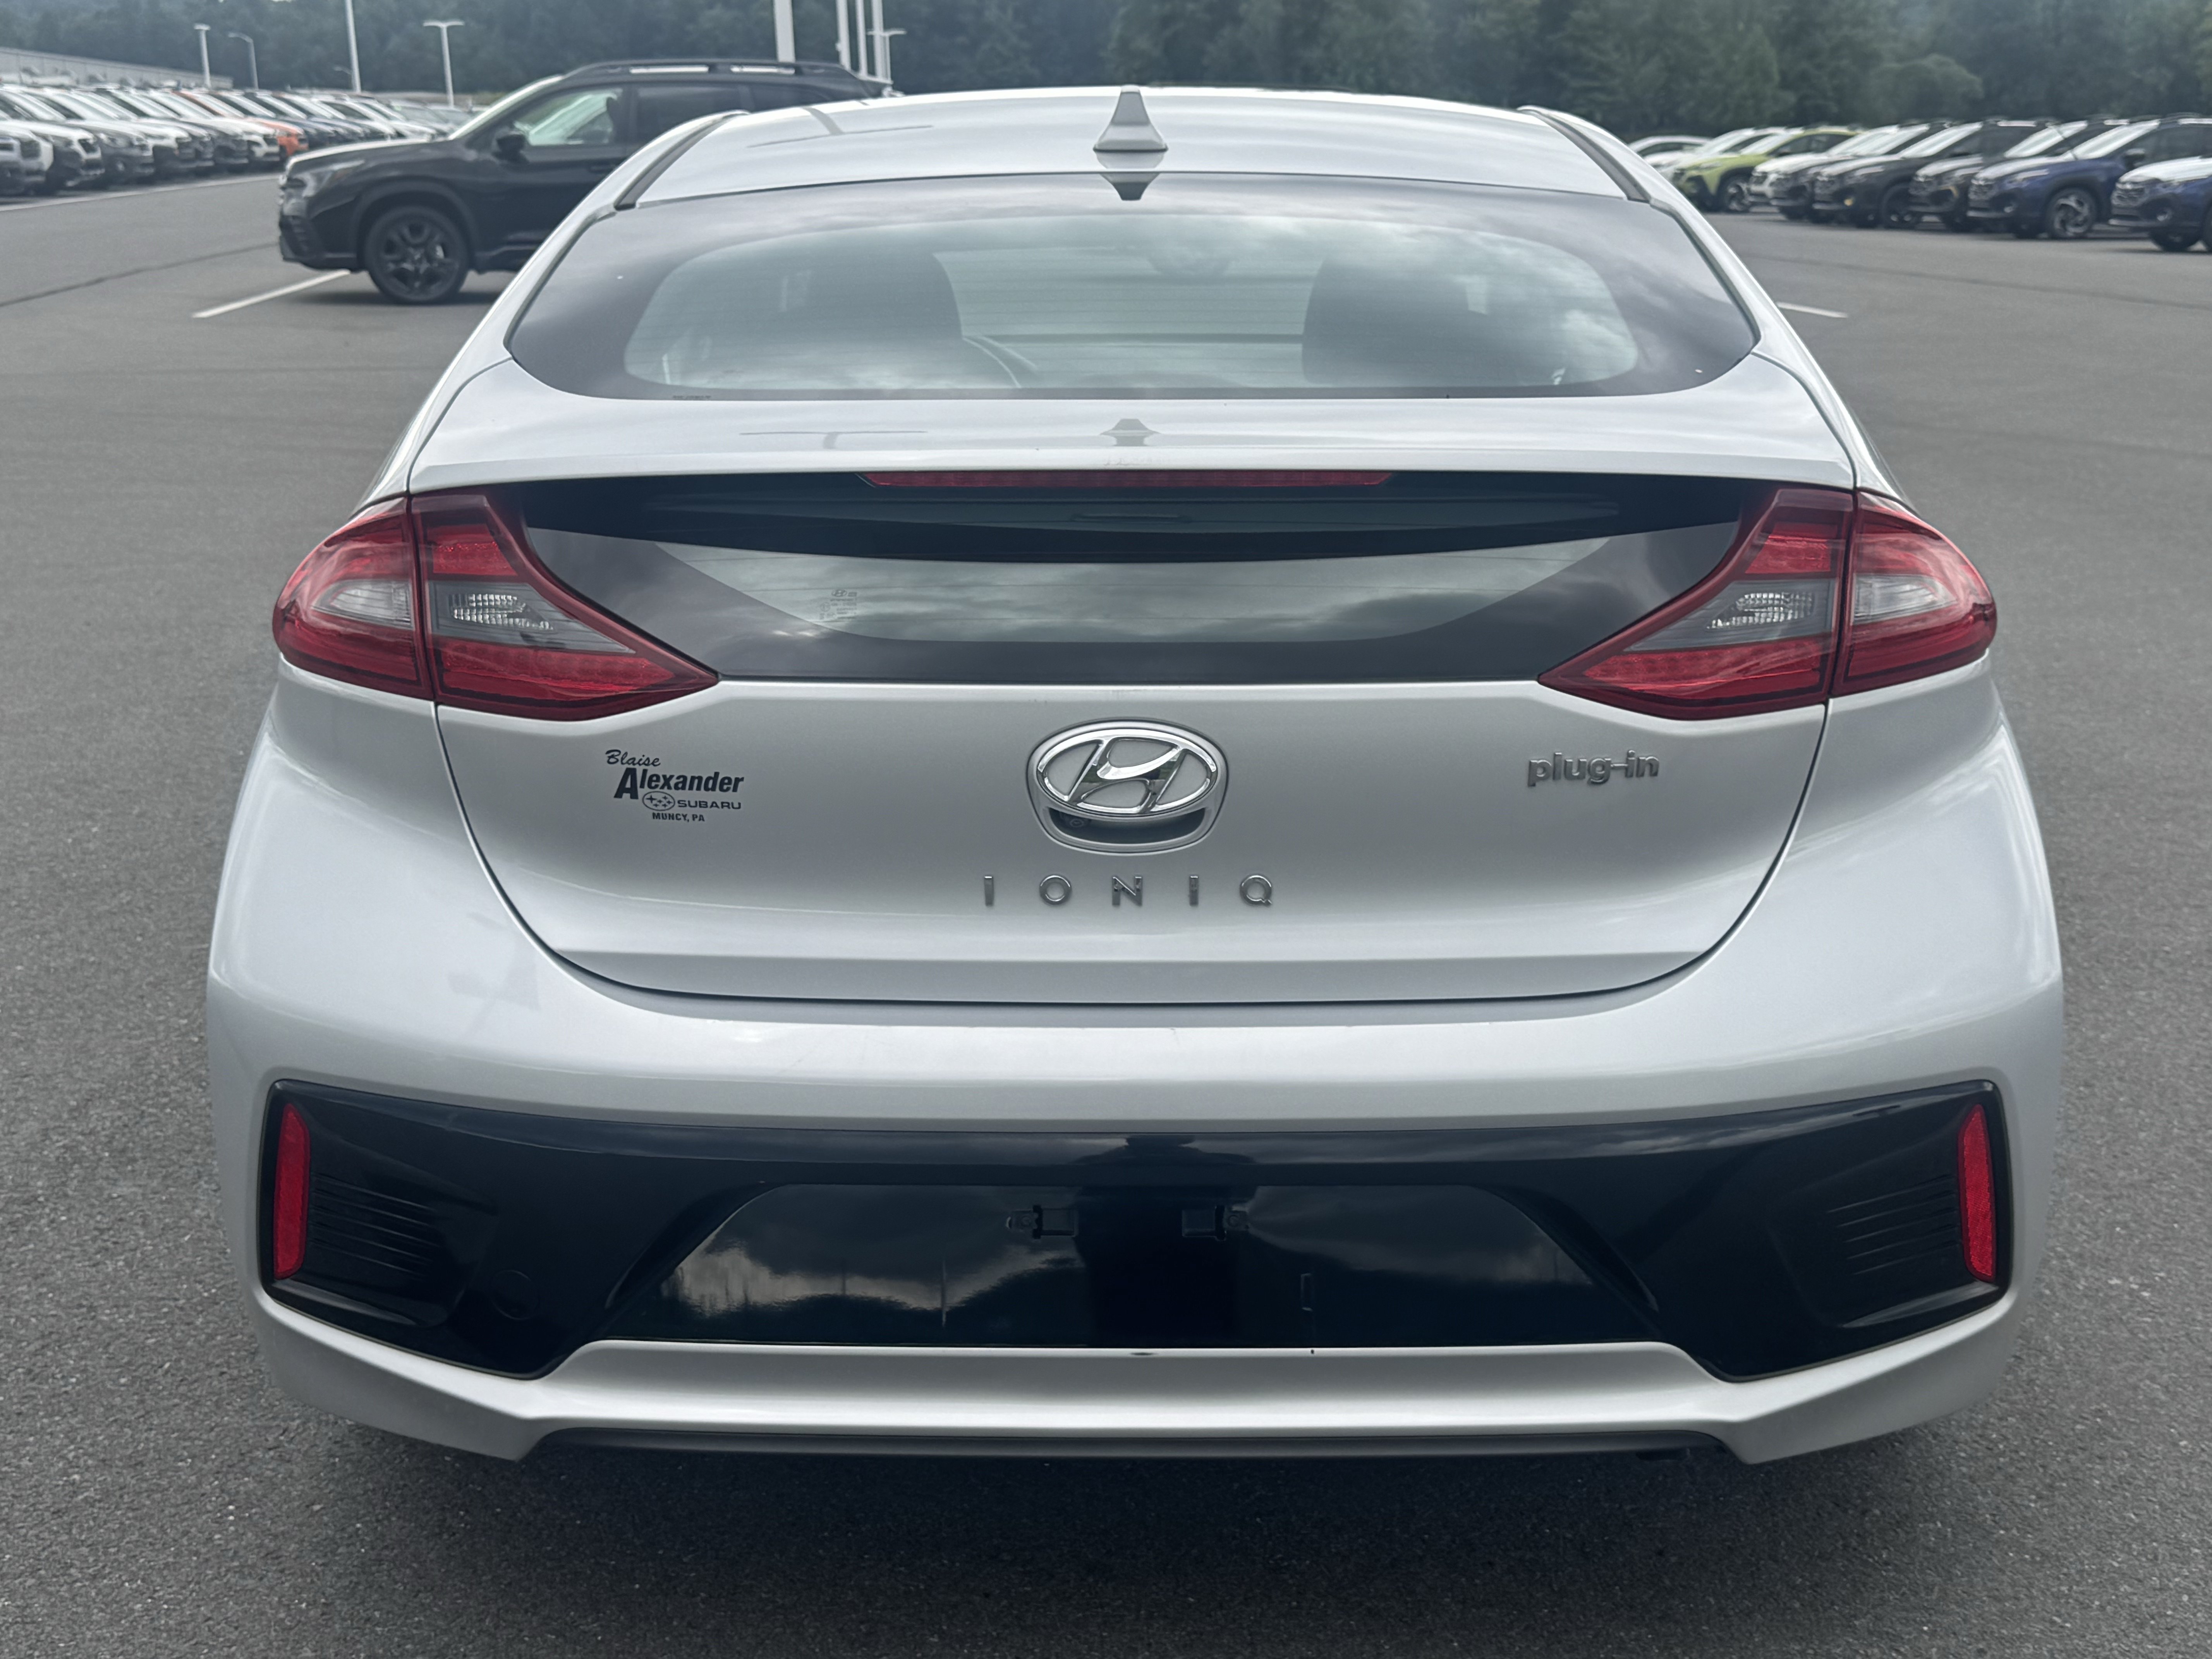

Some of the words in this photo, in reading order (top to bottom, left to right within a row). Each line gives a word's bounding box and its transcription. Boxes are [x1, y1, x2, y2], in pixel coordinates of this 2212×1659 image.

[605, 749, 661, 767] Blaise
[1528, 749, 1659, 787] plug-in
[613, 767, 744, 800] Alexander
[677, 800, 741, 809] SUBARU
[652, 812, 690, 823] MUNCY,
[984, 874, 1273, 907] IONIQ
